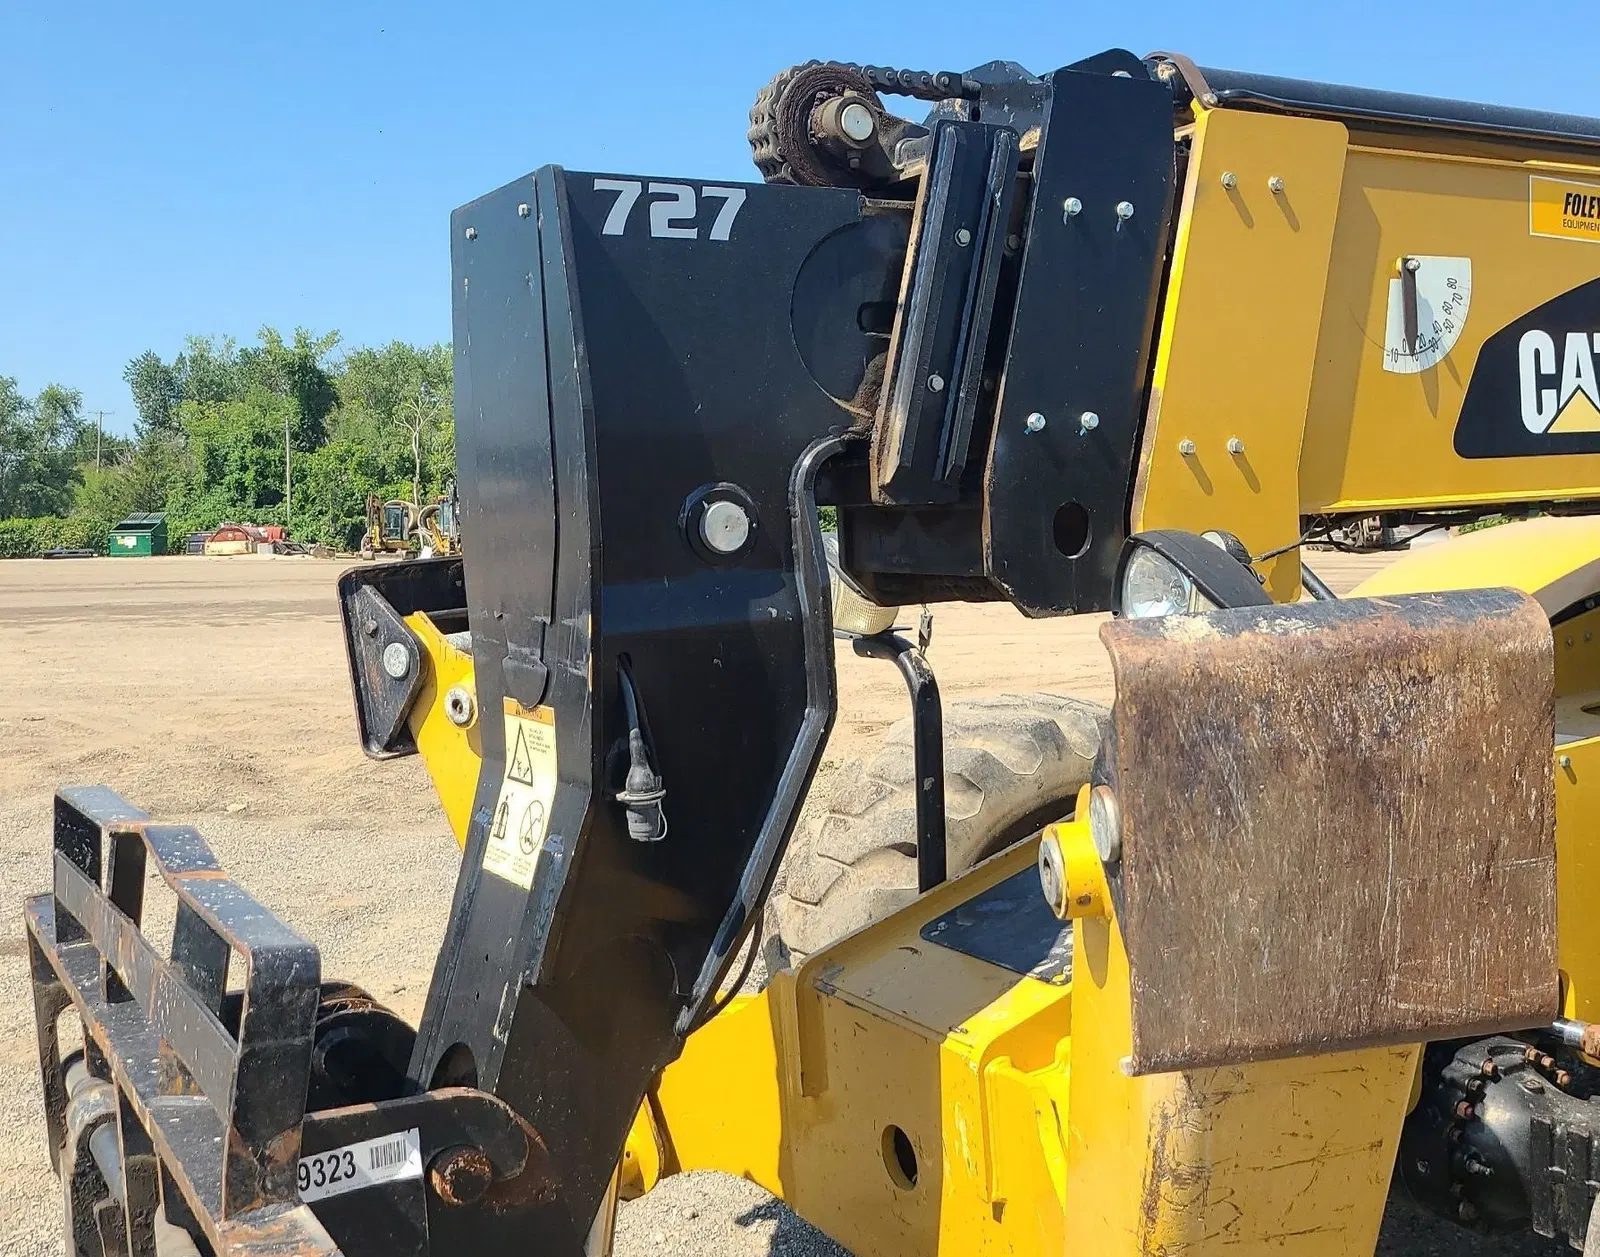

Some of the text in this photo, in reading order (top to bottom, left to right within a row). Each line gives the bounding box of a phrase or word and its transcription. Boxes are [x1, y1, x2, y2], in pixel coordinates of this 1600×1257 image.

[593, 178, 747, 241] 727
[1447, 277, 1457, 289] 80
[1452, 292, 1463, 306] 70
[1442, 301, 1453, 315] 60
[1432, 320, 1442, 335] 40
[1443, 318, 1454, 333] 50
[1417, 332, 1426, 349] 20
[1429, 336, 1438, 353] 30
[1518, 329, 1600, 434] CA
[298, 1150, 356, 1191] 9323
